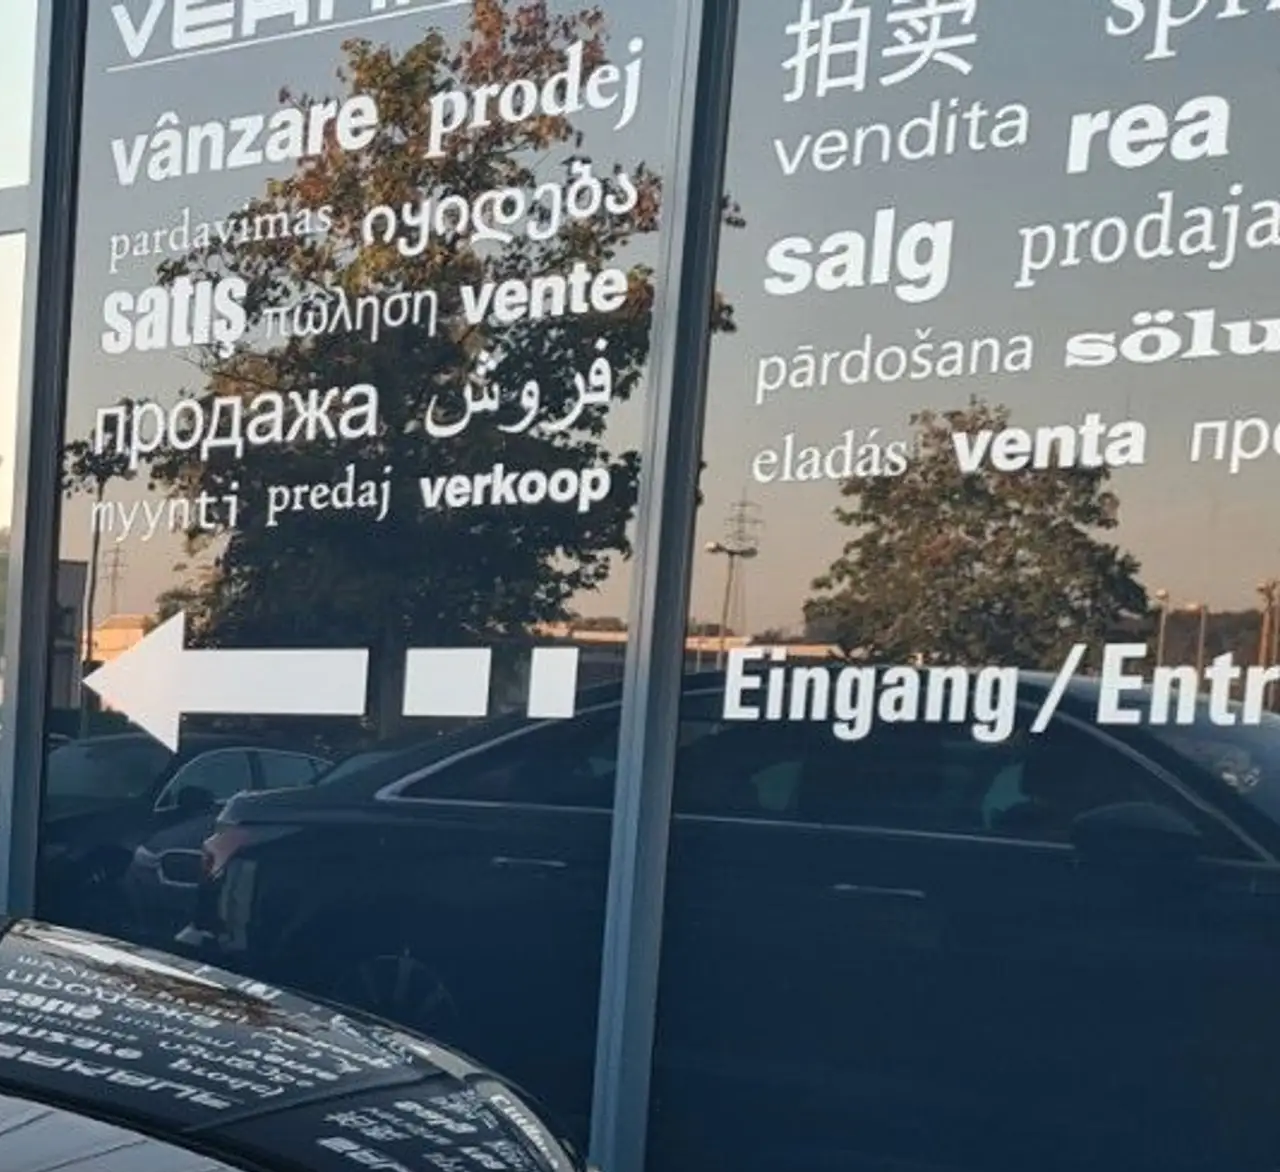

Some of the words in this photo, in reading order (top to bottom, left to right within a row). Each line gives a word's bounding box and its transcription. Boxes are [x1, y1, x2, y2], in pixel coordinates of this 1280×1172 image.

[110, 95, 380, 187] vânzare
[424, 36, 645, 158] prodej
[774, 96, 1030, 175] vendita
[1066, 95, 1231, 174] rea
[108, 203, 333, 275] pardavimas
[763, 206, 954, 302] salg
[1013, 183, 1280, 289] prodaja
[101, 275, 248, 359] satış
[460, 262, 628, 325] vente
[424, 336, 612, 438] فروش
[755, 327, 1034, 404] pārdošana
[92, 381, 380, 468] продажа
[752, 428, 909, 484] eladás
[952, 412, 1147, 474] venta
[1190, 416, 1280, 474] пр
[91, 481, 240, 542] myynti
[266, 464, 393, 527] predaj
[419, 463, 612, 513] verkoop
[722, 645, 1019, 744] Eingang
